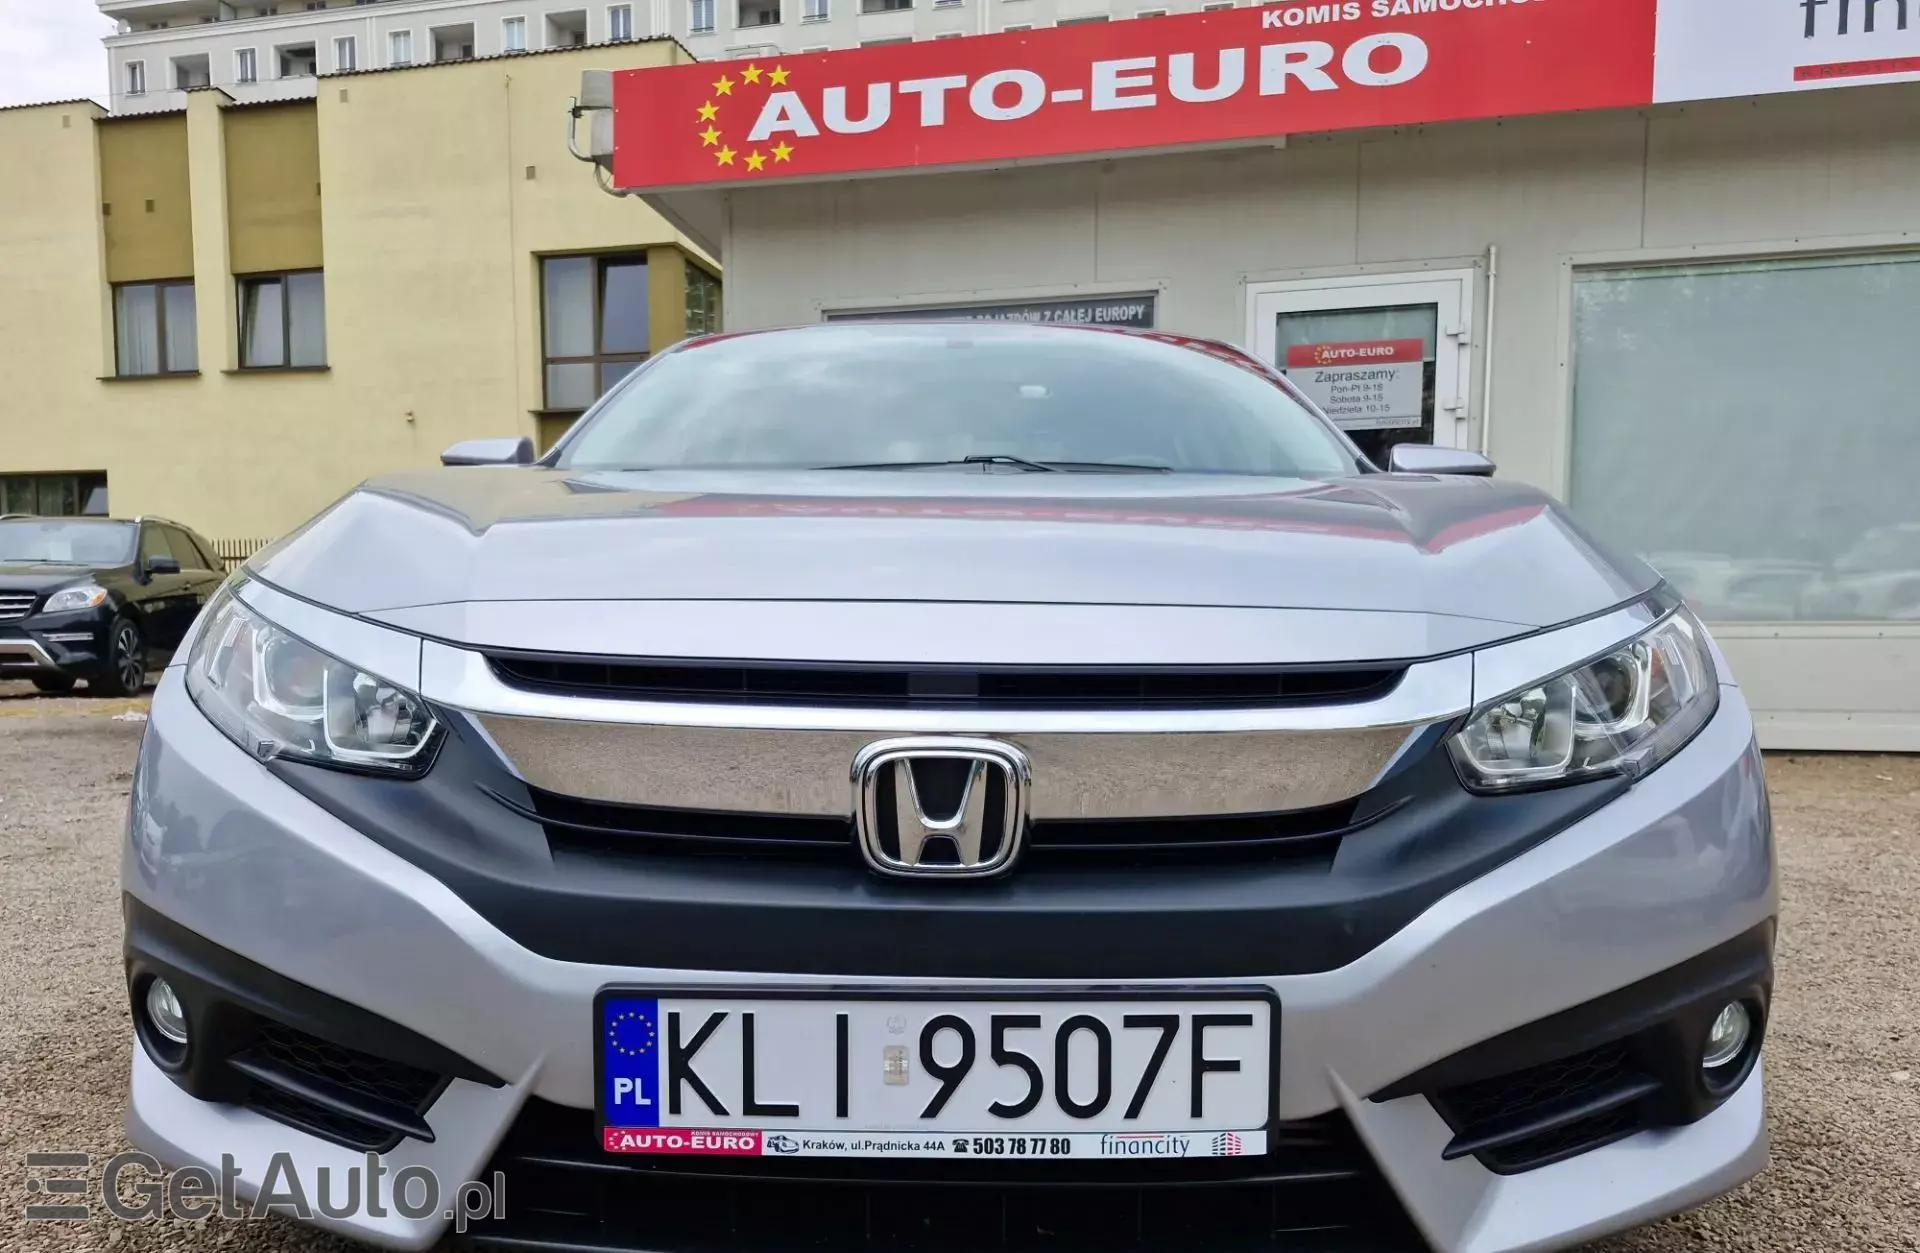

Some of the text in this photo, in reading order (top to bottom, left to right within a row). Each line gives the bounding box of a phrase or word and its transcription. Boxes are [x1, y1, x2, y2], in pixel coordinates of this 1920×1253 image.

[1262, 3, 1361, 28] KOMIS
[1800, 0, 1920, 38] fin
[746, 32, 1429, 142] AUTO-EURO
[1054, 308, 1093, 323] CAŁEJ
[1095, 305, 1145, 322] EUROPY
[1321, 346, 1394, 359] AUTO-EURO
[1330, 394, 1360, 404] Sobota
[1366, 403, 1390, 413] 10-15
[919, 1013, 1253, 1119] 9507F
[614, 1077, 652, 1106] PL
[620, 1135, 755, 1150] AUTO-EURO
[802, 1138, 1071, 1155] Kraków, ul.Prądnicka 44A 503 78 77 80
[1100, 1134, 1190, 1157] financity
